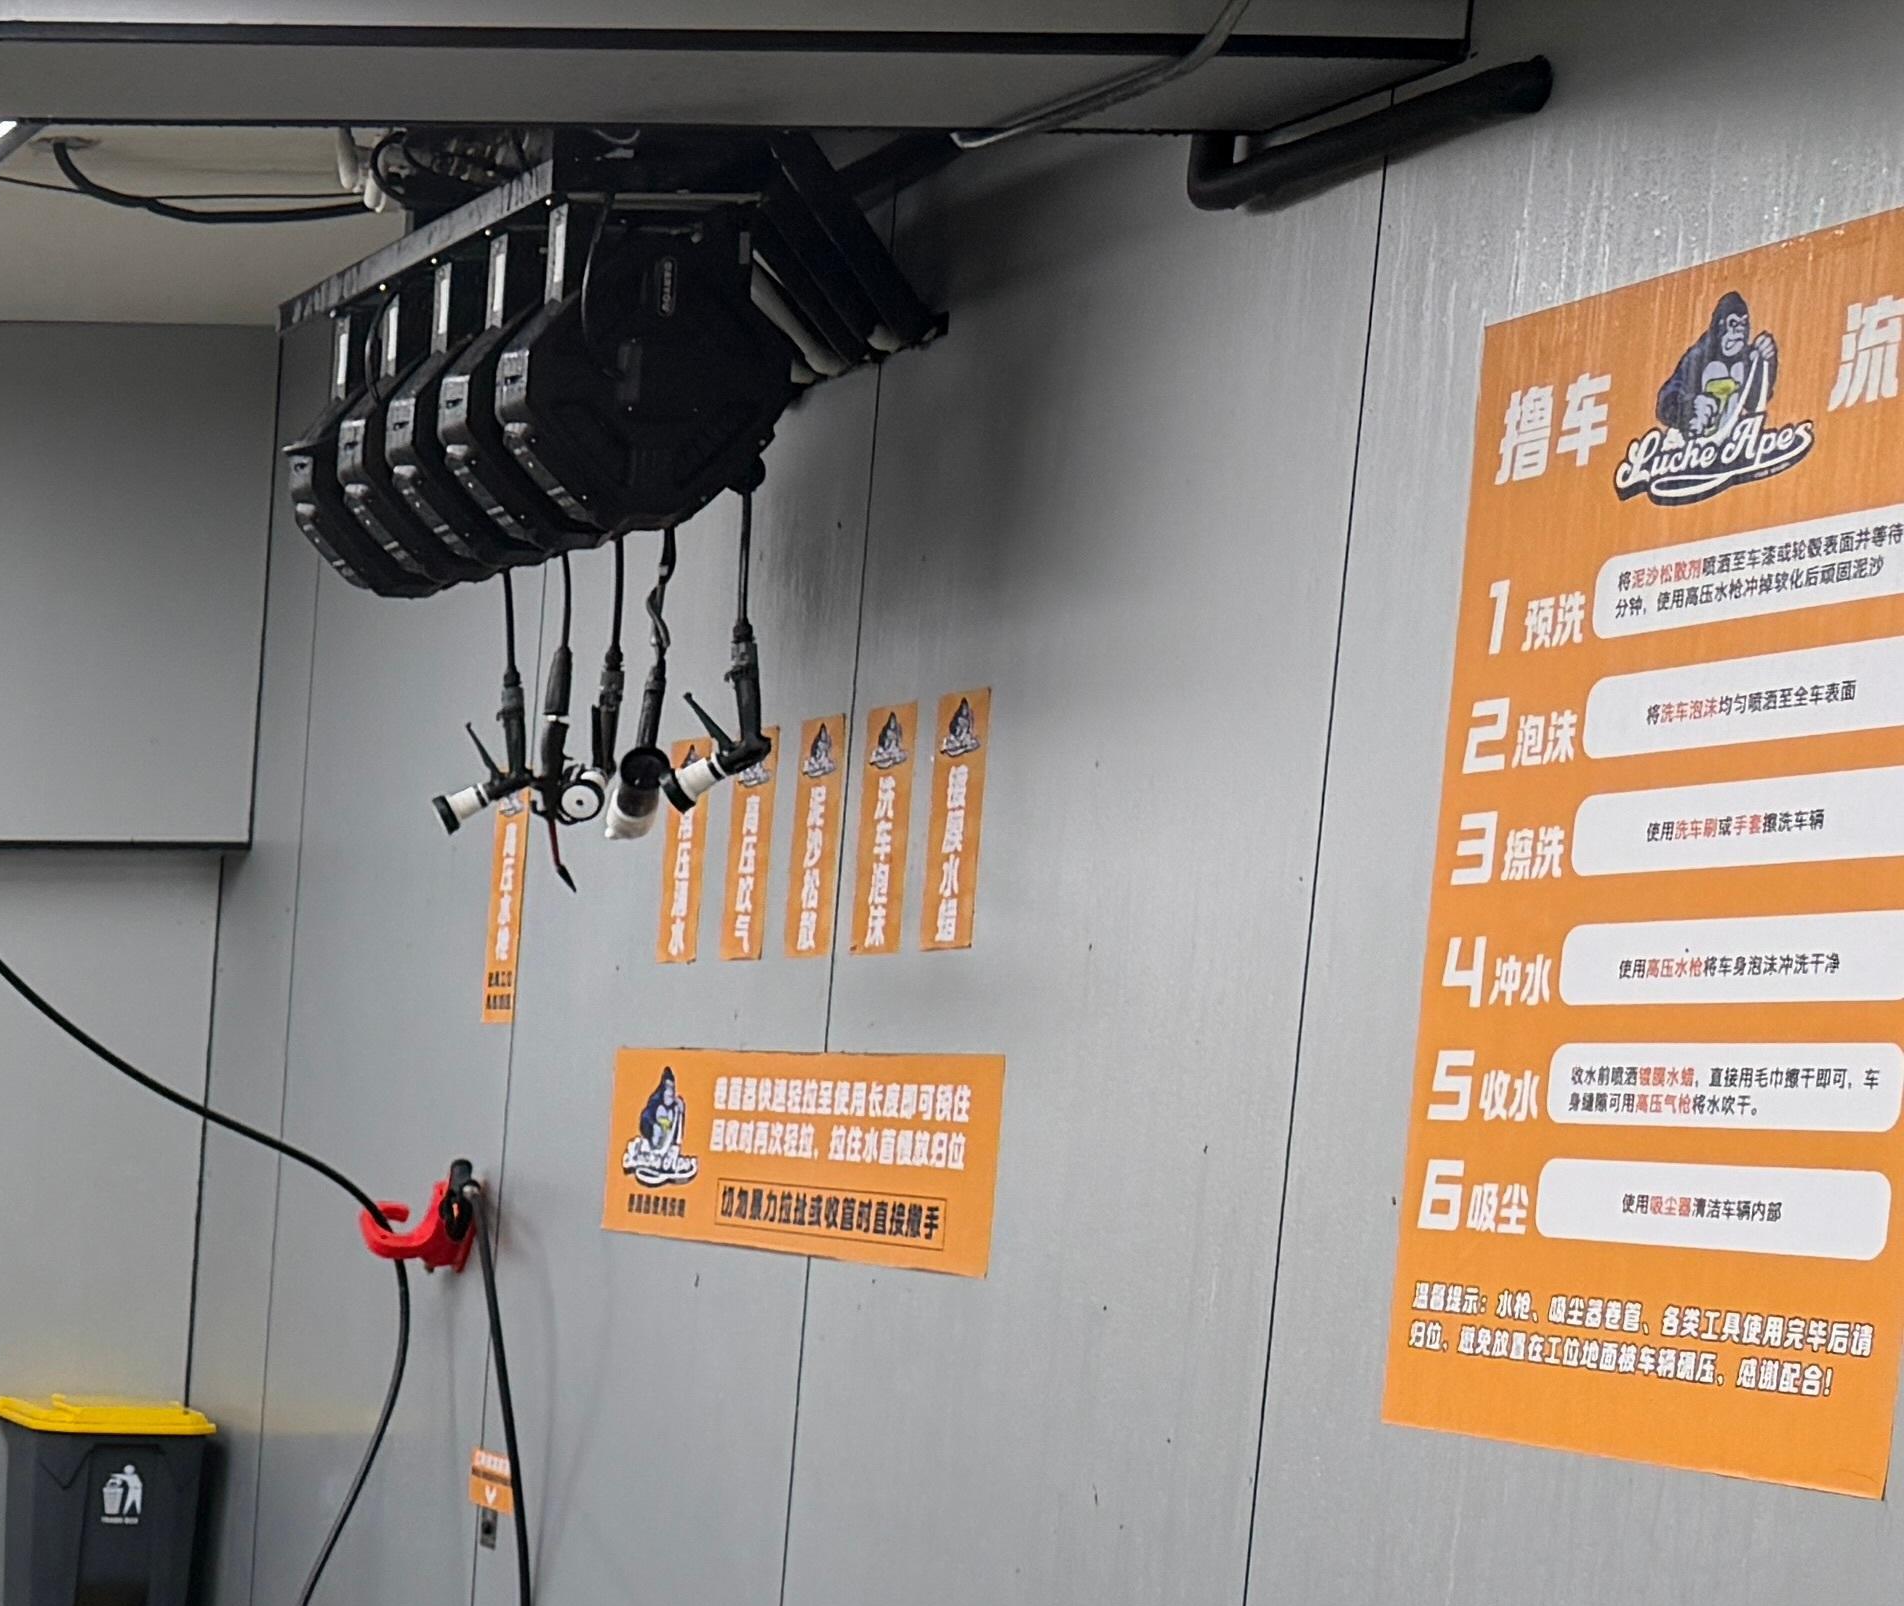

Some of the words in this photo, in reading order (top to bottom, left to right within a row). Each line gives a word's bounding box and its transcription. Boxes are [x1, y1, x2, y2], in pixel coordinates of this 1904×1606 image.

[1494, 372, 1612, 486] 撸车
[1616, 429, 1716, 489] Luche
[1721, 414, 1814, 466] Apes
[1489, 579, 1510, 654] 1
[1520, 591, 1586, 652] 预洗
[1462, 697, 1511, 774] 2
[1511, 709, 1578, 768] 泡沫
[1646, 680, 1857, 725] 将洗车泡沫均匀喷洒至全车表面
[1450, 811, 1498, 886] 3
[1500, 826, 1565, 881] 擦洗
[1646, 809, 1825, 843] 使用洗车刷或手套擦洗车辆
[1441, 936, 1488, 1008] 4
[1488, 953, 1552, 1007] 冲水
[1618, 952, 1840, 979] 使用高压水枪将车身泡沫冲洗干净
[1427, 1049, 1475, 1121] 5
[1479, 1069, 1540, 1122] 收水
[1417, 1159, 1464, 1231] 6
[1465, 1183, 1529, 1235] 吸尘
[1622, 1193, 1783, 1222] 使用吸尘器清洁车辆内部
